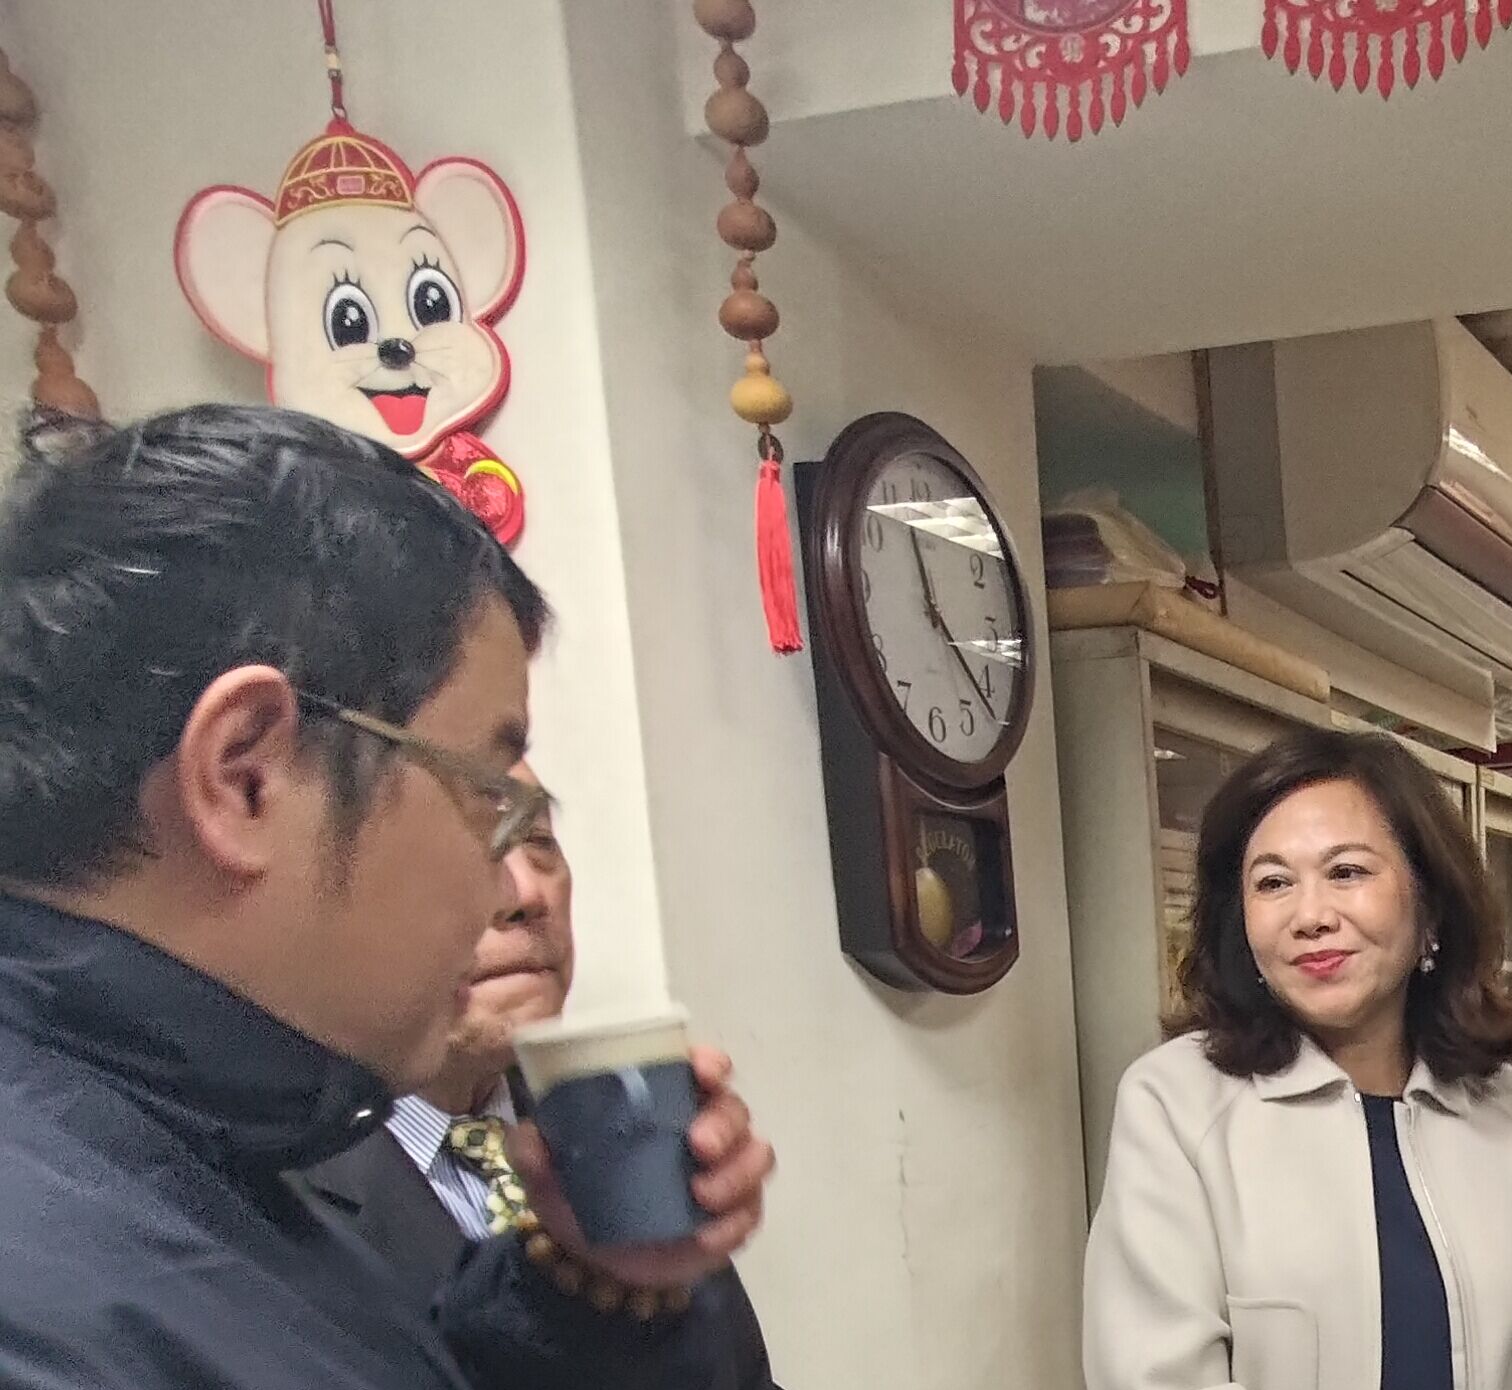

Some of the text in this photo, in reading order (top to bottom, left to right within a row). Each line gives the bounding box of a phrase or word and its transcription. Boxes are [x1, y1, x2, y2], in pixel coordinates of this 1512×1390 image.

[969, 553, 985, 589] 2
[897, 680, 912, 715] 7
[978, 664, 996, 698] 4
[928, 706, 946, 743] 6
[959, 699, 975, 736] 5
